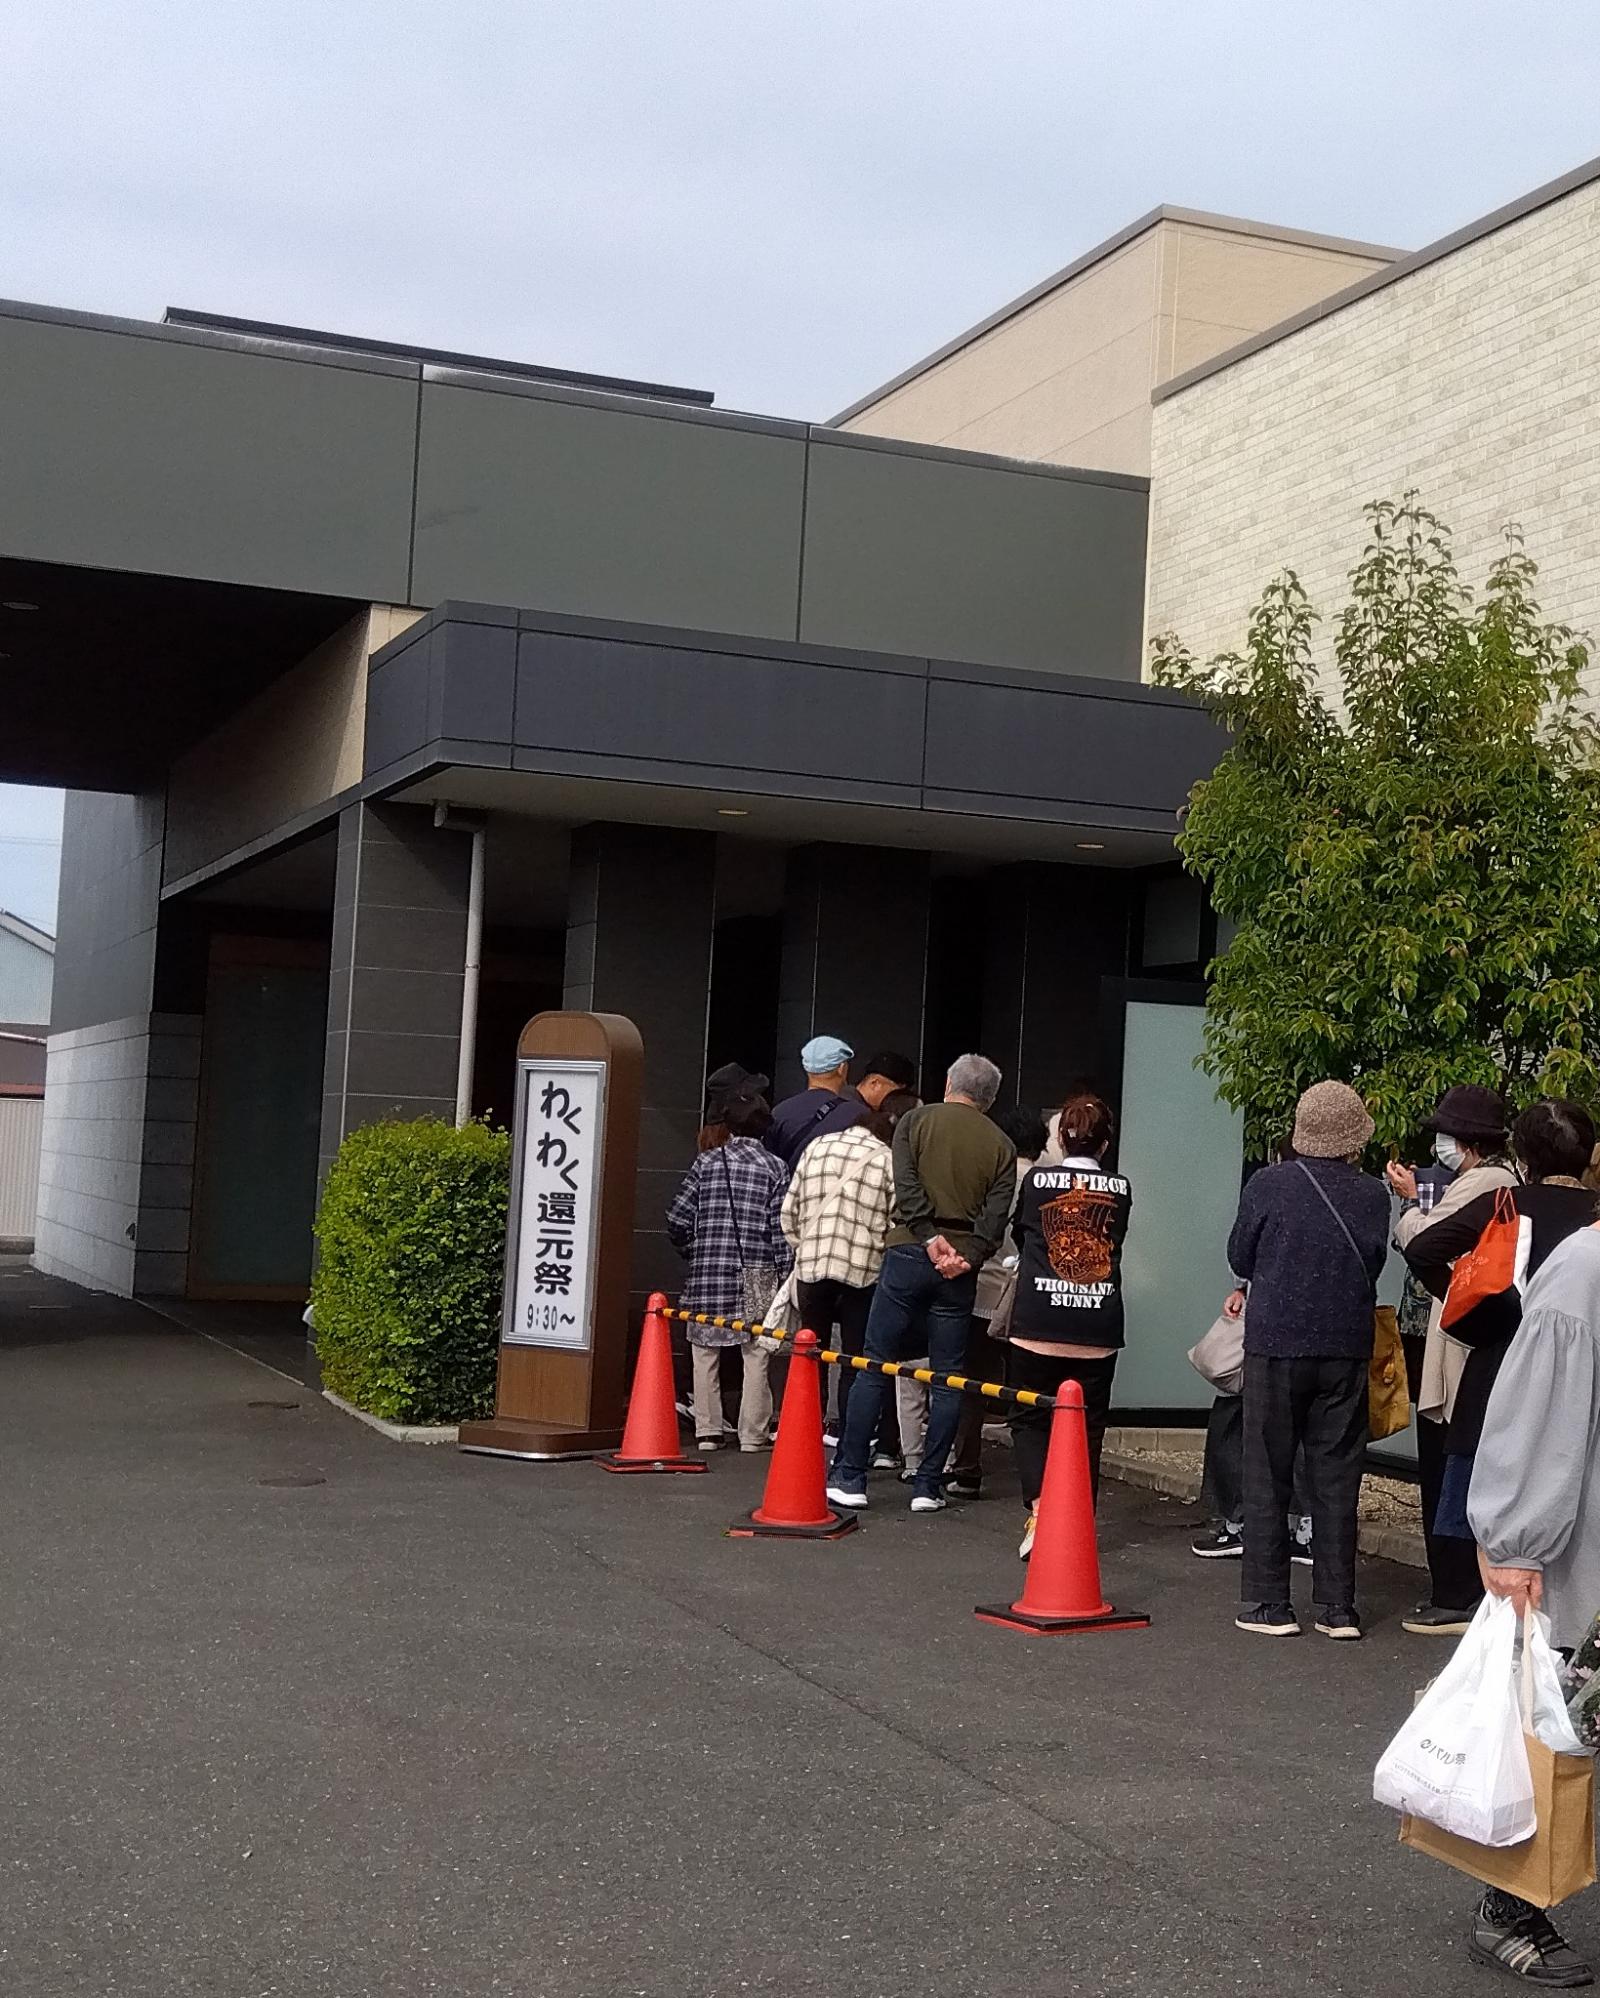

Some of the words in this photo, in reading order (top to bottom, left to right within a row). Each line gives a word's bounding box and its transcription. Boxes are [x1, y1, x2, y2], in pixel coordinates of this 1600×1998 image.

[534, 1080, 582, 1296] わくわく還元祭
[1033, 1172, 1071, 1189] ONE
[1075, 1173, 1128, 1196] PIECE
[1050, 1292, 1104, 1309] SUNNY
